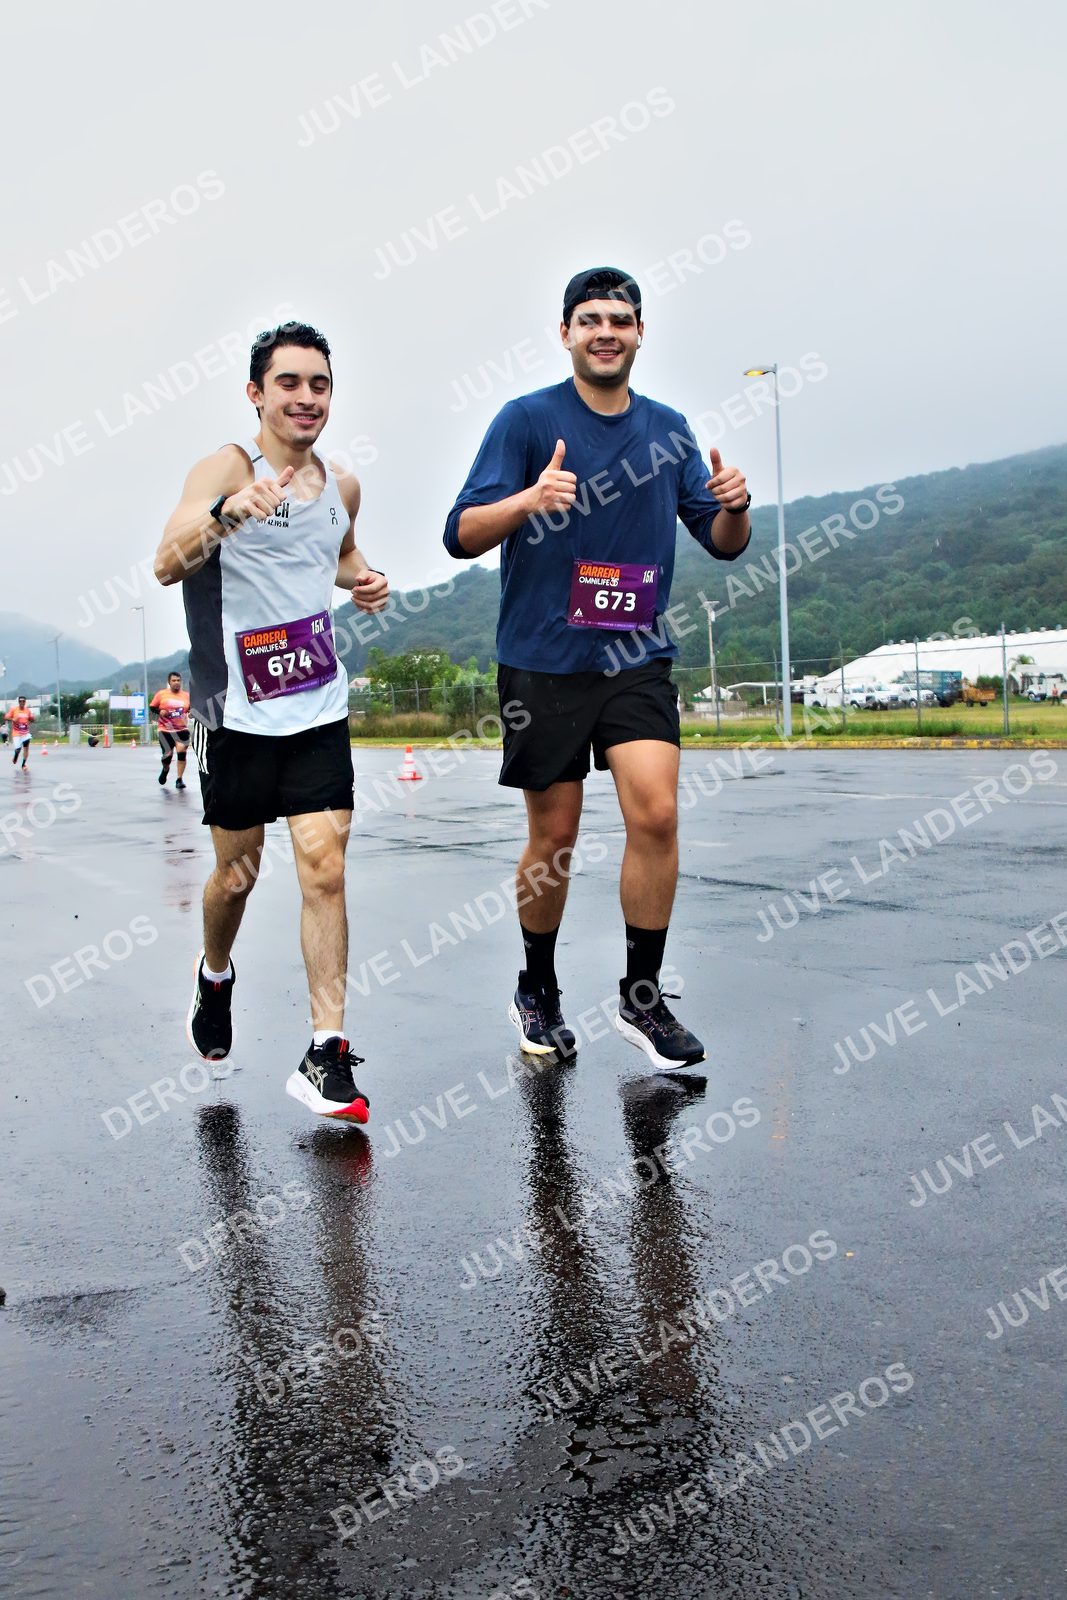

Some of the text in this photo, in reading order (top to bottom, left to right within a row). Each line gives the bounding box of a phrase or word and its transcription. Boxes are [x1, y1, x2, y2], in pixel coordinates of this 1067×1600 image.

[579, 564, 621, 578] CARRERA
[642, 570, 655, 584] 15K
[594, 590, 637, 612] 673
[310, 617, 325, 635] 15K
[243, 629, 287, 648] CARRERA
[267, 649, 312, 676] 674
